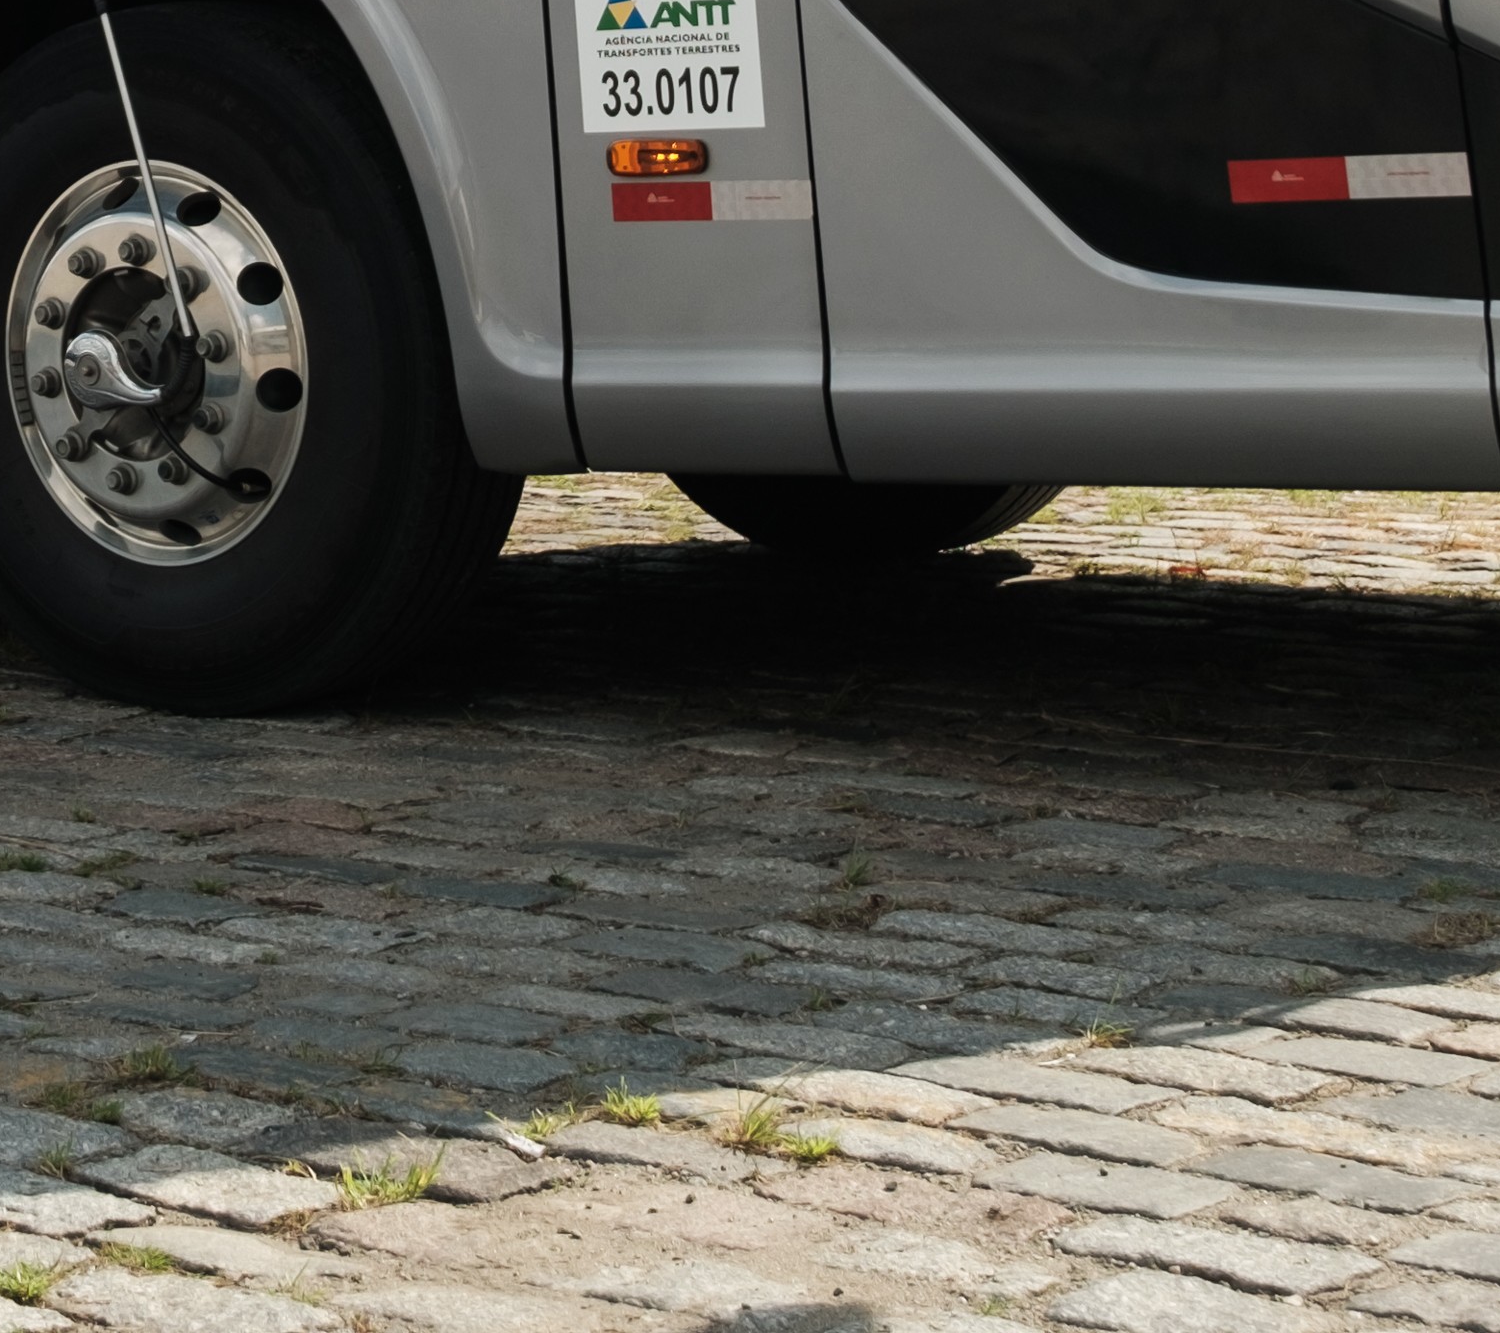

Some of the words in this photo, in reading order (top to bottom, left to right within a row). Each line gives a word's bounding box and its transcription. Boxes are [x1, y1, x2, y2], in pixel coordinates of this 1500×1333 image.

[605, 34, 653, 46] AGÊNCIA
[655, 32, 713, 44] NACIONAL
[715, 31, 730, 41] DE
[597, 47, 672, 58] TRANSPORTES
[675, 44, 741, 55] TERRESTRES
[601, 65, 740, 118] 33.0107
